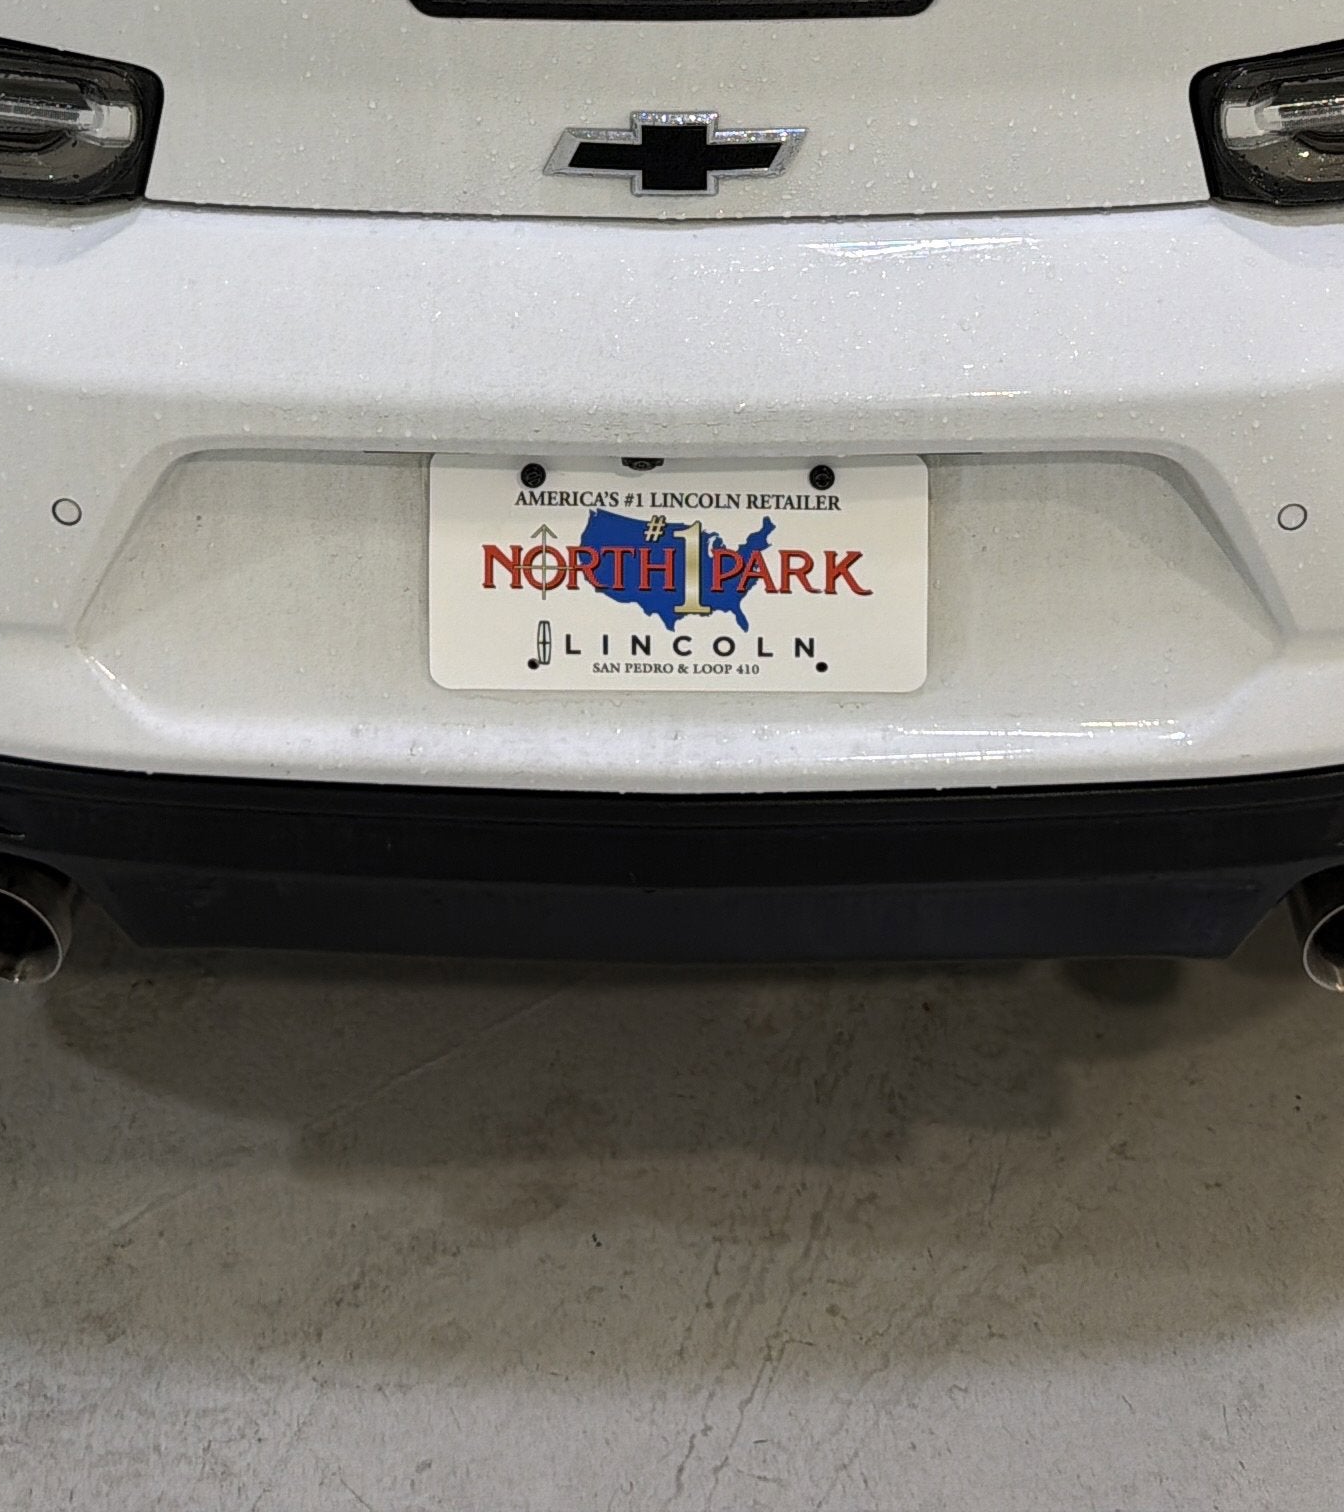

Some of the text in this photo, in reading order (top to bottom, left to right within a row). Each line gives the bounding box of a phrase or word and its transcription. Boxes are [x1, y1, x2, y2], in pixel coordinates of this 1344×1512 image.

[514, 490, 842, 511] AMERICA'S #1 LINCOLN RETAILER
[481, 543, 875, 597] NORTH PARK
[564, 633, 816, 659] LINCOLN
[592, 661, 761, 676] SAN PEDRO & LOOP 410
